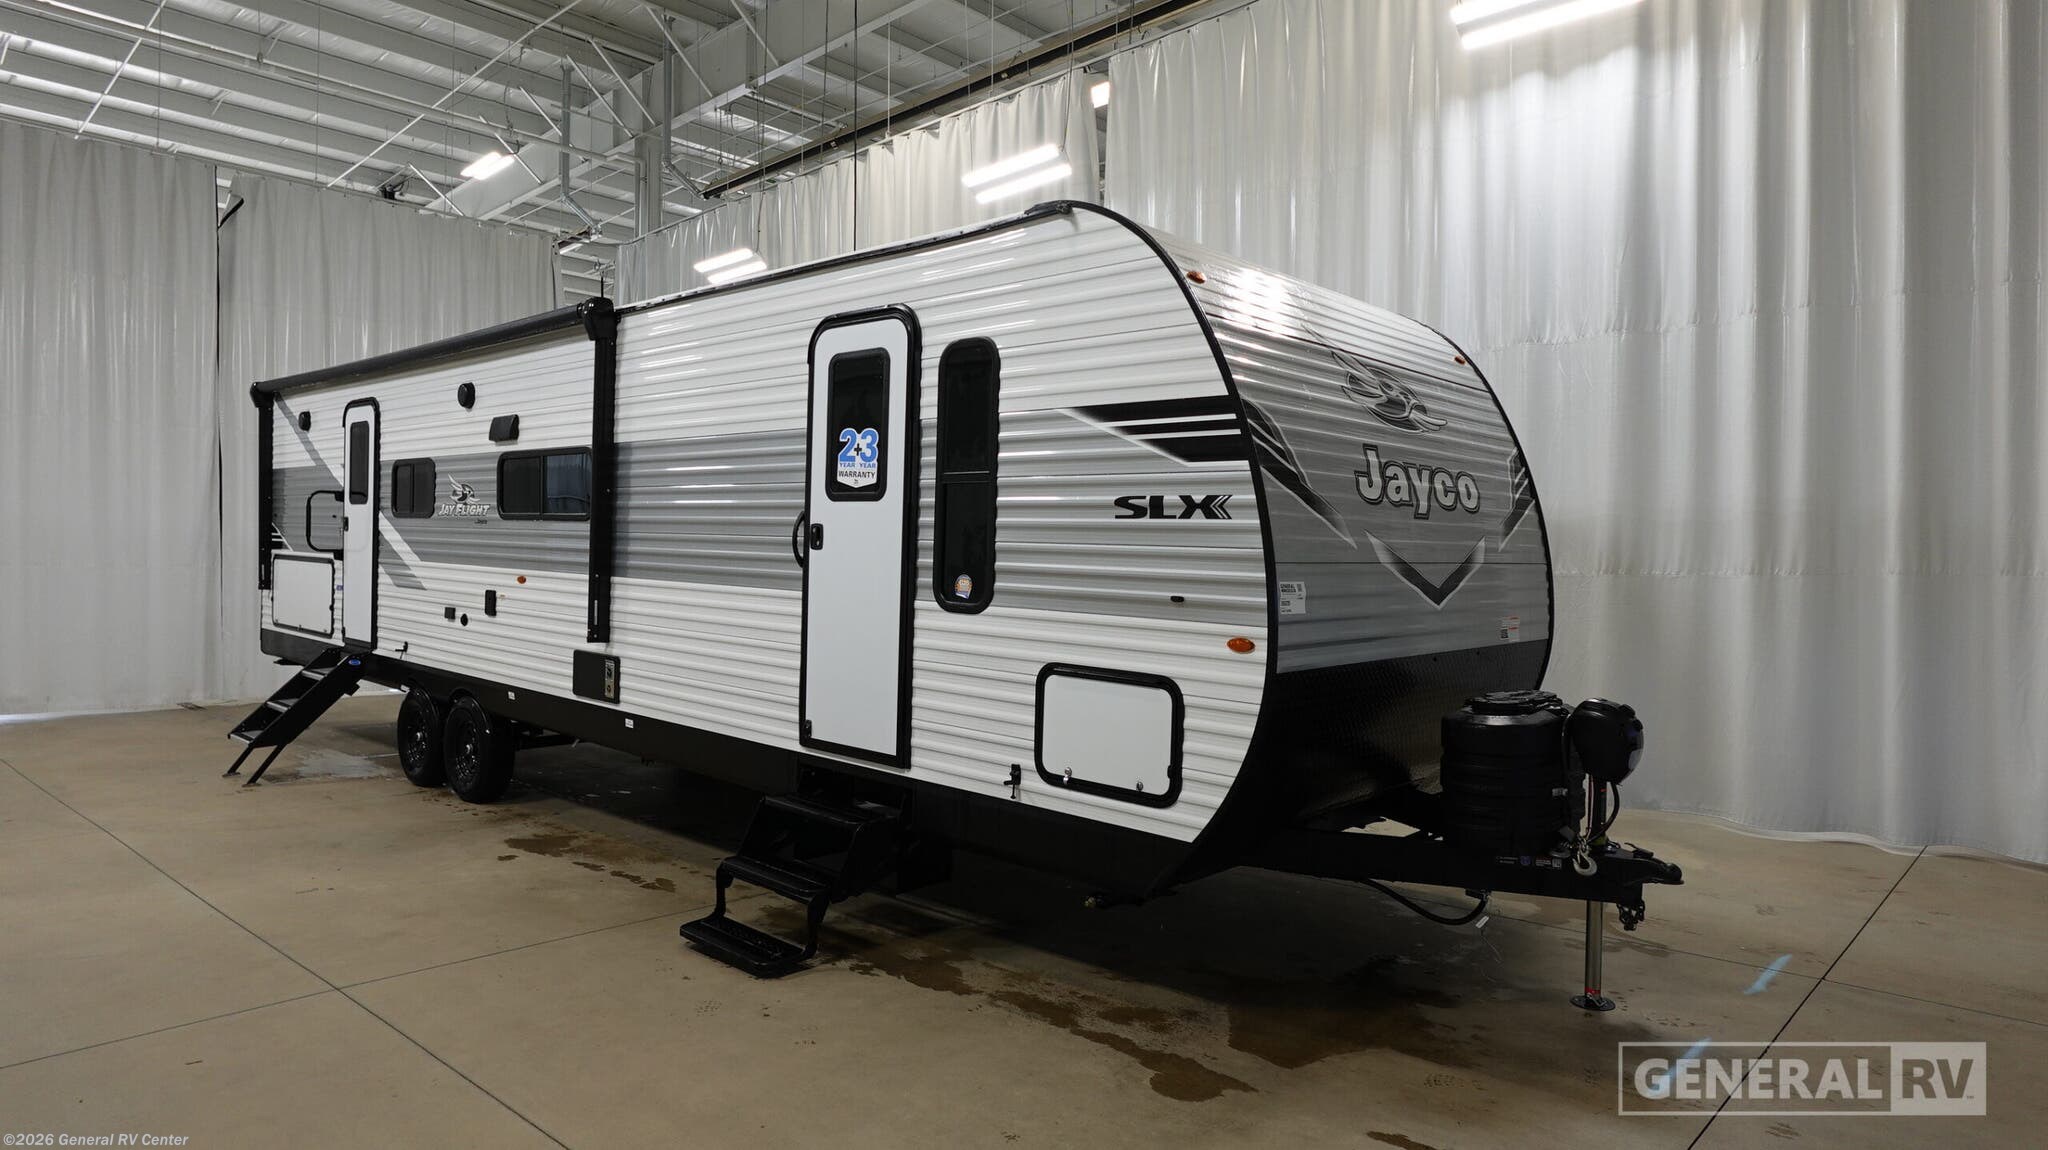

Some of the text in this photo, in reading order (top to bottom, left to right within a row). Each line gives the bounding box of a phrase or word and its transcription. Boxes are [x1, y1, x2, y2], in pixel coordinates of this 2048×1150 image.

[839, 470, 876, 479] WARRANTY
[1354, 443, 1480, 520] Jayco
[438, 503, 490, 516] JAY FLIGHT
[1114, 495, 1233, 519] SLX
